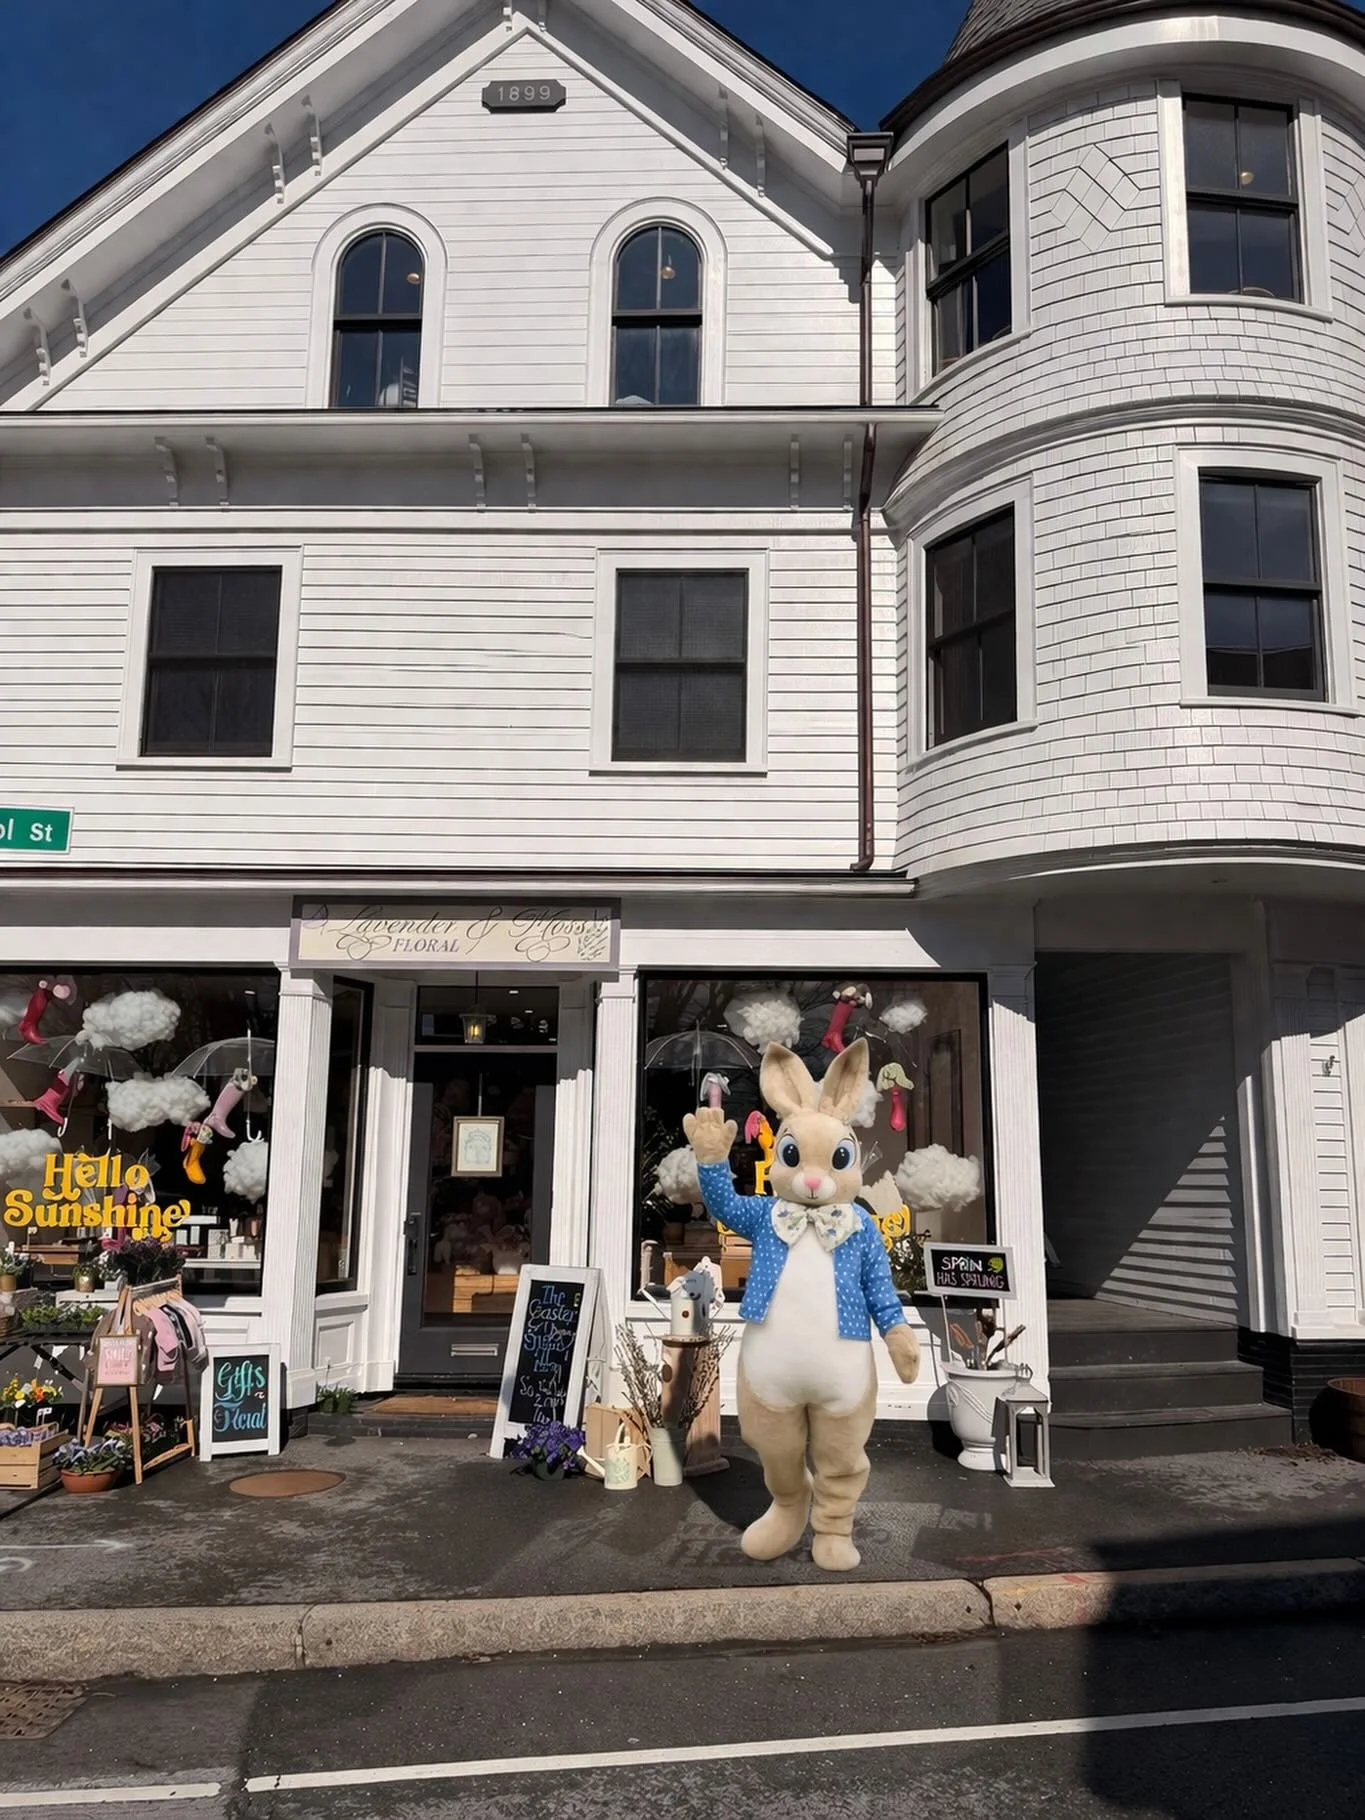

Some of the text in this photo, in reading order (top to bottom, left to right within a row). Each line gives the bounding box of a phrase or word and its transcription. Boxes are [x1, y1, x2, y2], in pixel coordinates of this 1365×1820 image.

[497, 85, 551, 102] 1899
[29, 822, 53, 842] St
[327, 904, 586, 962] Lavender & Moss
[392, 937, 460, 953] FLORAL
[42, 1152, 149, 1201] Hello
[3, 1188, 191, 1241] Sunshine
[215, 1360, 266, 1401] Gifts
